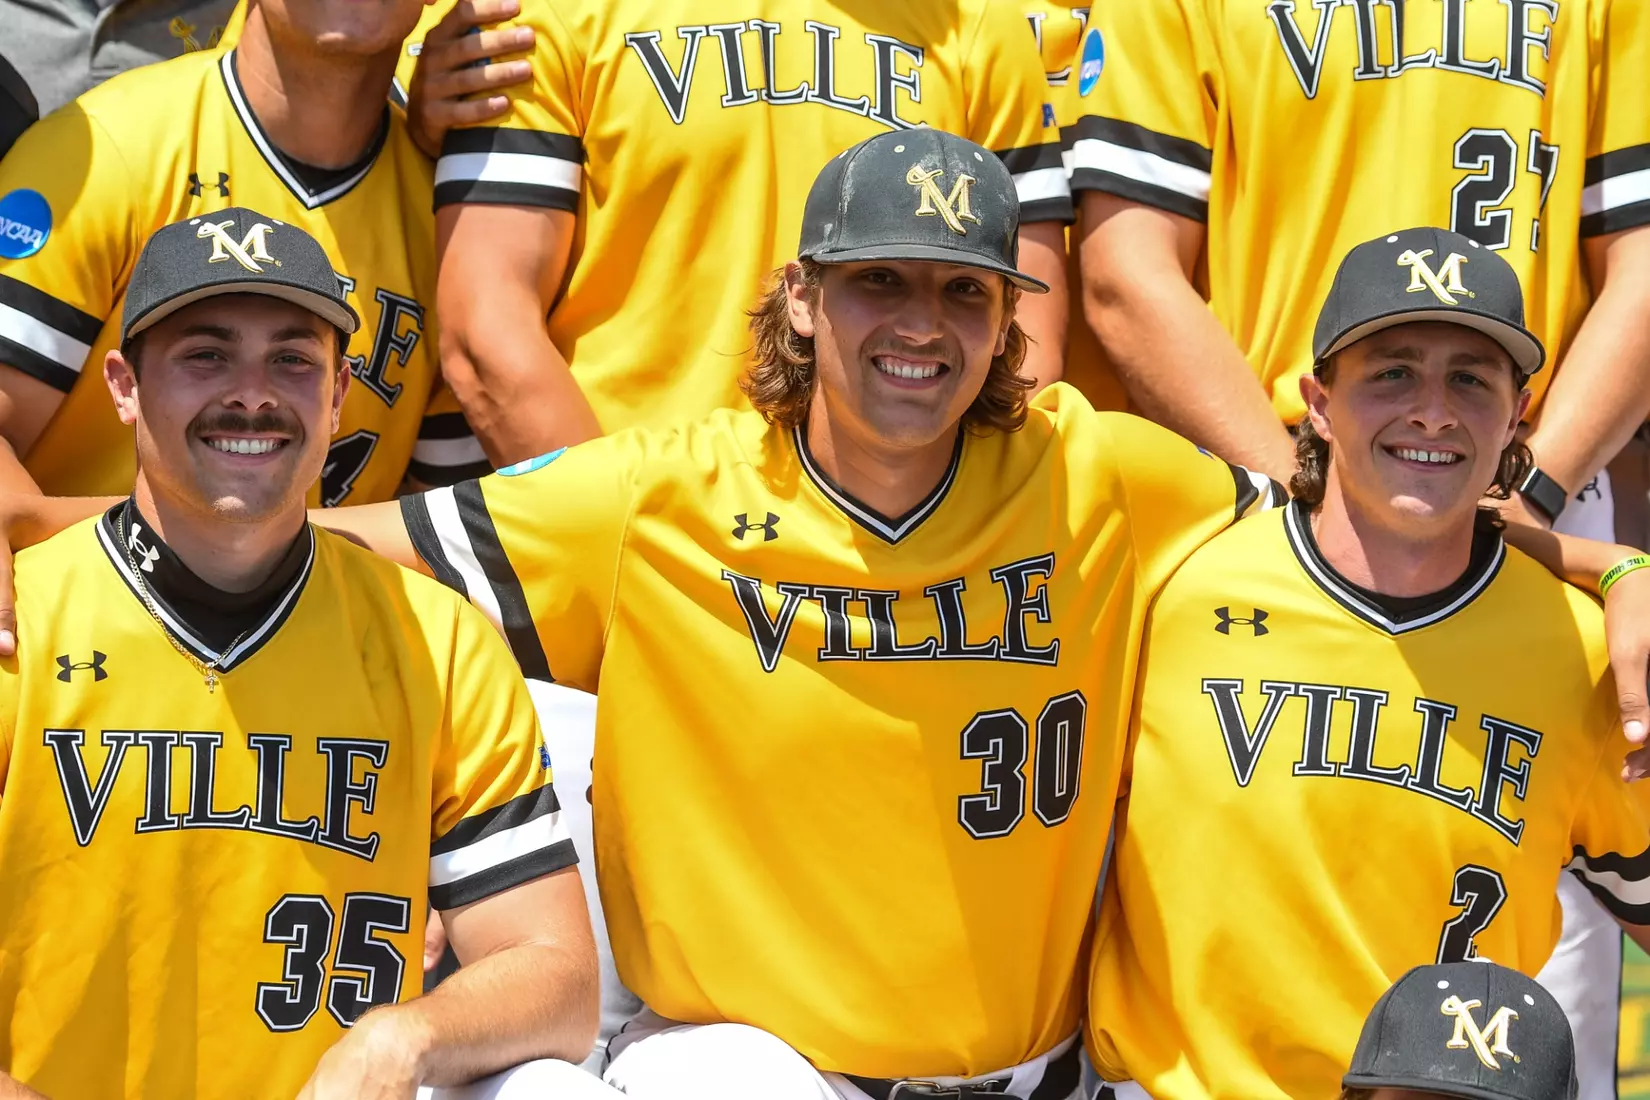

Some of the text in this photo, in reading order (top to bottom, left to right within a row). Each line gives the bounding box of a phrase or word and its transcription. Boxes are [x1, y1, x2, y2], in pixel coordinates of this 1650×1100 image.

[625, 20, 925, 130] VILLE
[1266, 0, 1558, 98] VILLE
[196, 219, 275, 273] M
[906, 165, 978, 235] M
[1397, 249, 1470, 305] M
[722, 552, 1059, 673] VILLE
[43, 729, 390, 862] VILLE
[958, 690, 1087, 839] 30
[1202, 678, 1544, 847] VILLE
[256, 892, 411, 1032] 35
[1436, 863, 1506, 964] 2
[1439, 995, 1518, 1069] M
